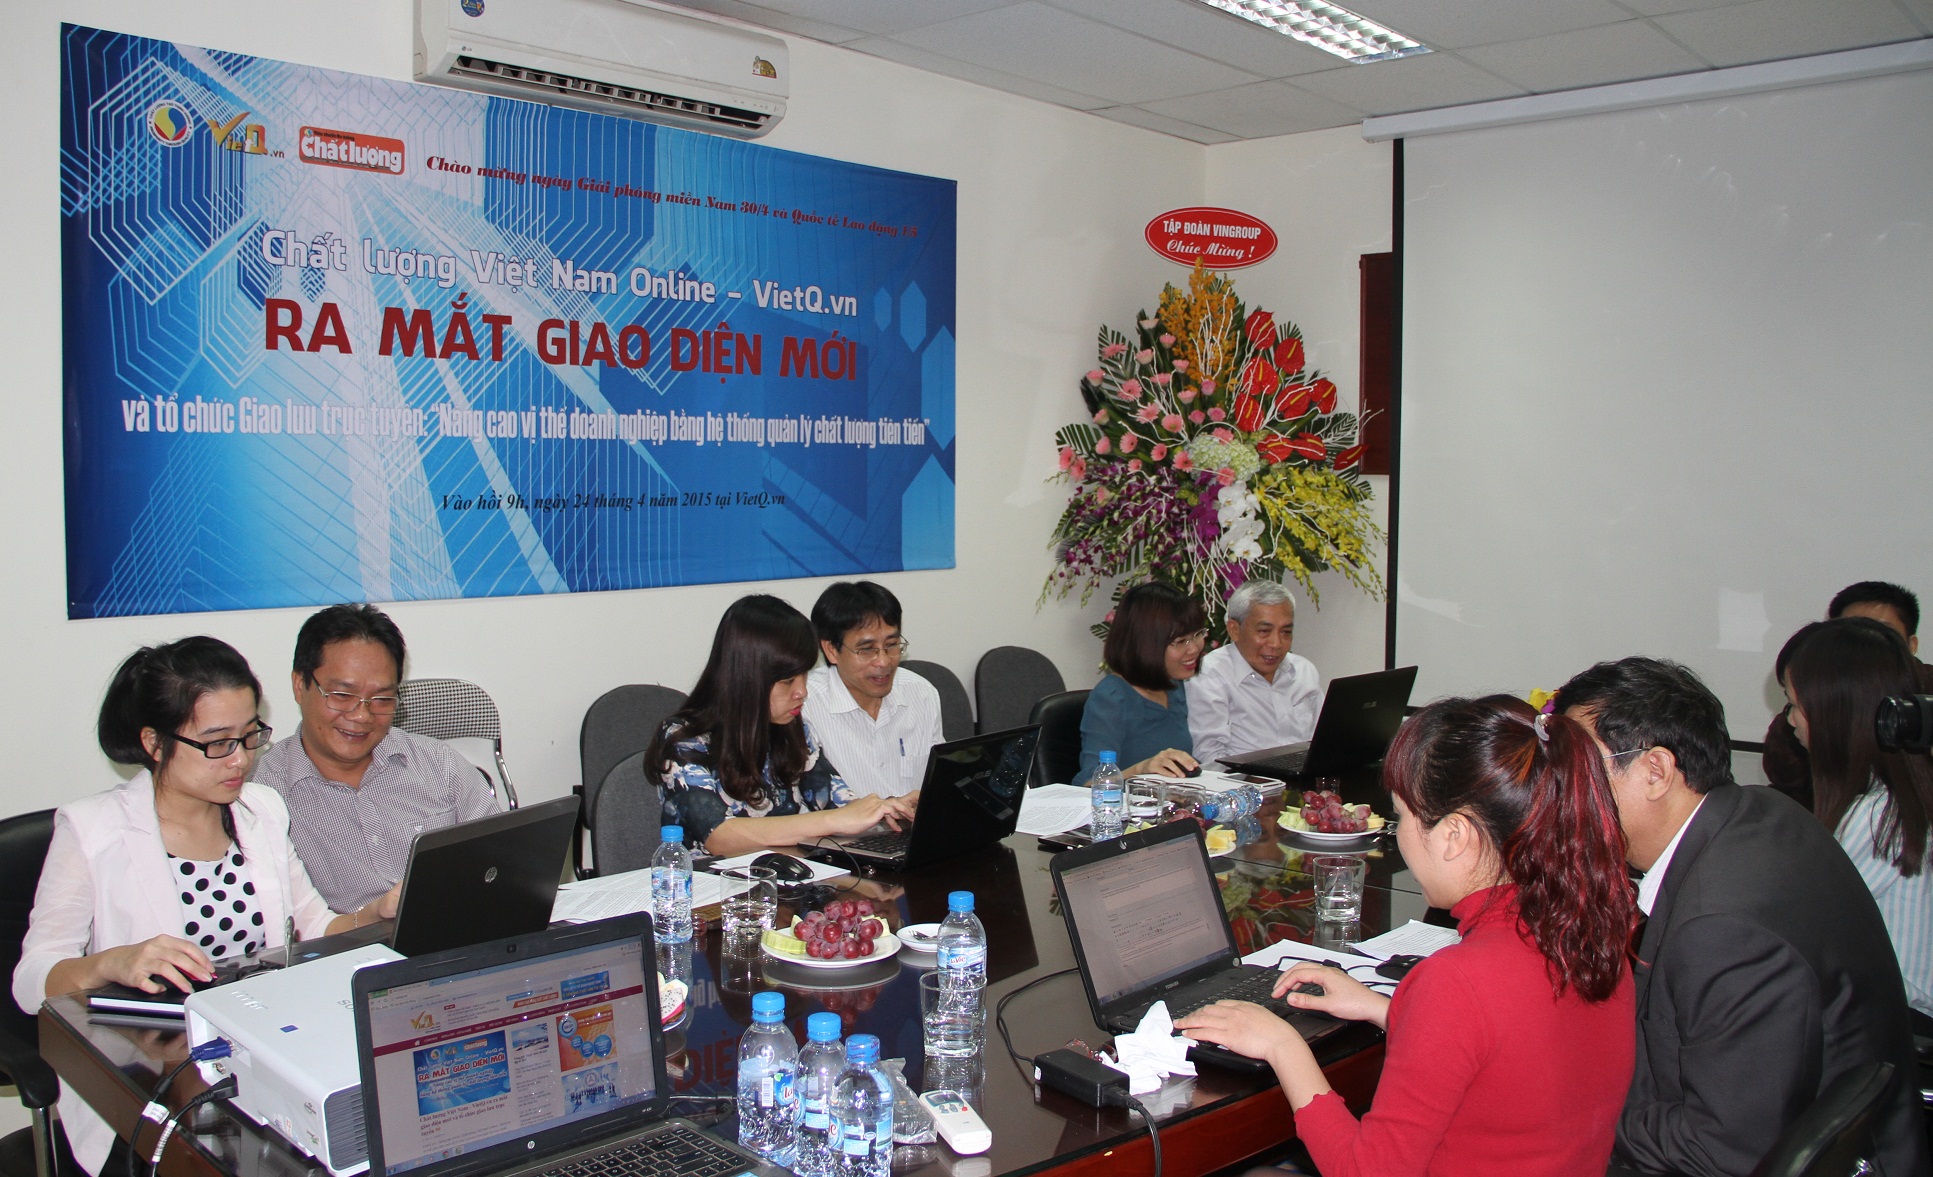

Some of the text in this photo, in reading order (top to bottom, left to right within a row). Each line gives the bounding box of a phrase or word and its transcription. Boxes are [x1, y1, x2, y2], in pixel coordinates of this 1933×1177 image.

[426, 156, 472, 174] Chào
[477, 167, 527, 185] mừng
[532, 175, 572, 191] ngày
[578, 177, 611, 194] Giải
[614, 184, 662, 203] phóng
[666, 192, 701, 207] miền
[704, 196, 736, 212] Nam
[740, 201, 770, 217] 30/4
[773, 208, 788, 219] và
[792, 208, 824, 226] Quốc
[827, 213, 839, 226] tế
[842, 216, 865, 231] Lao
[868, 220, 899, 237] động
[1164, 219, 1261, 239] TẬP ĐOÀN VINGROUP
[1167, 240, 1201, 255] Chúc
[262, 230, 347, 272] Chất
[363, 238, 457, 289] lượng
[470, 250, 538, 294] Việt
[551, 258, 617, 294] Nam
[630, 267, 716, 304] Online
[753, 279, 857, 316] VietQ.vn
[266, 292, 857, 384] RA MẮT GIAO DIỆN MỚI
[122, 395, 150, 432] và
[154, 392, 179, 433] tổ
[182, 395, 235, 433] chức
[238, 396, 282, 434] Giao
[286, 399, 317, 435] lưu
[486, 410, 518, 439] cao
[521, 406, 536, 444] vị
[540, 406, 567, 440] thế
[570, 407, 617, 440] doanh
[619, 409, 667, 446] nghiệp
[670, 409, 704, 446] bằng
[707, 412, 724, 447] hệ
[726, 412, 765, 447] thống
[767, 414, 798, 447] quản
[801, 414, 812, 447] lý
[814, 415, 843, 445] chất
[845, 416, 877, 449] lượng
[878, 418, 901, 445] tiên
[442, 490, 785, 513] Vào hồi 9h, ngày 24 tháng 4 năm 2015 tại VietQ.vn
